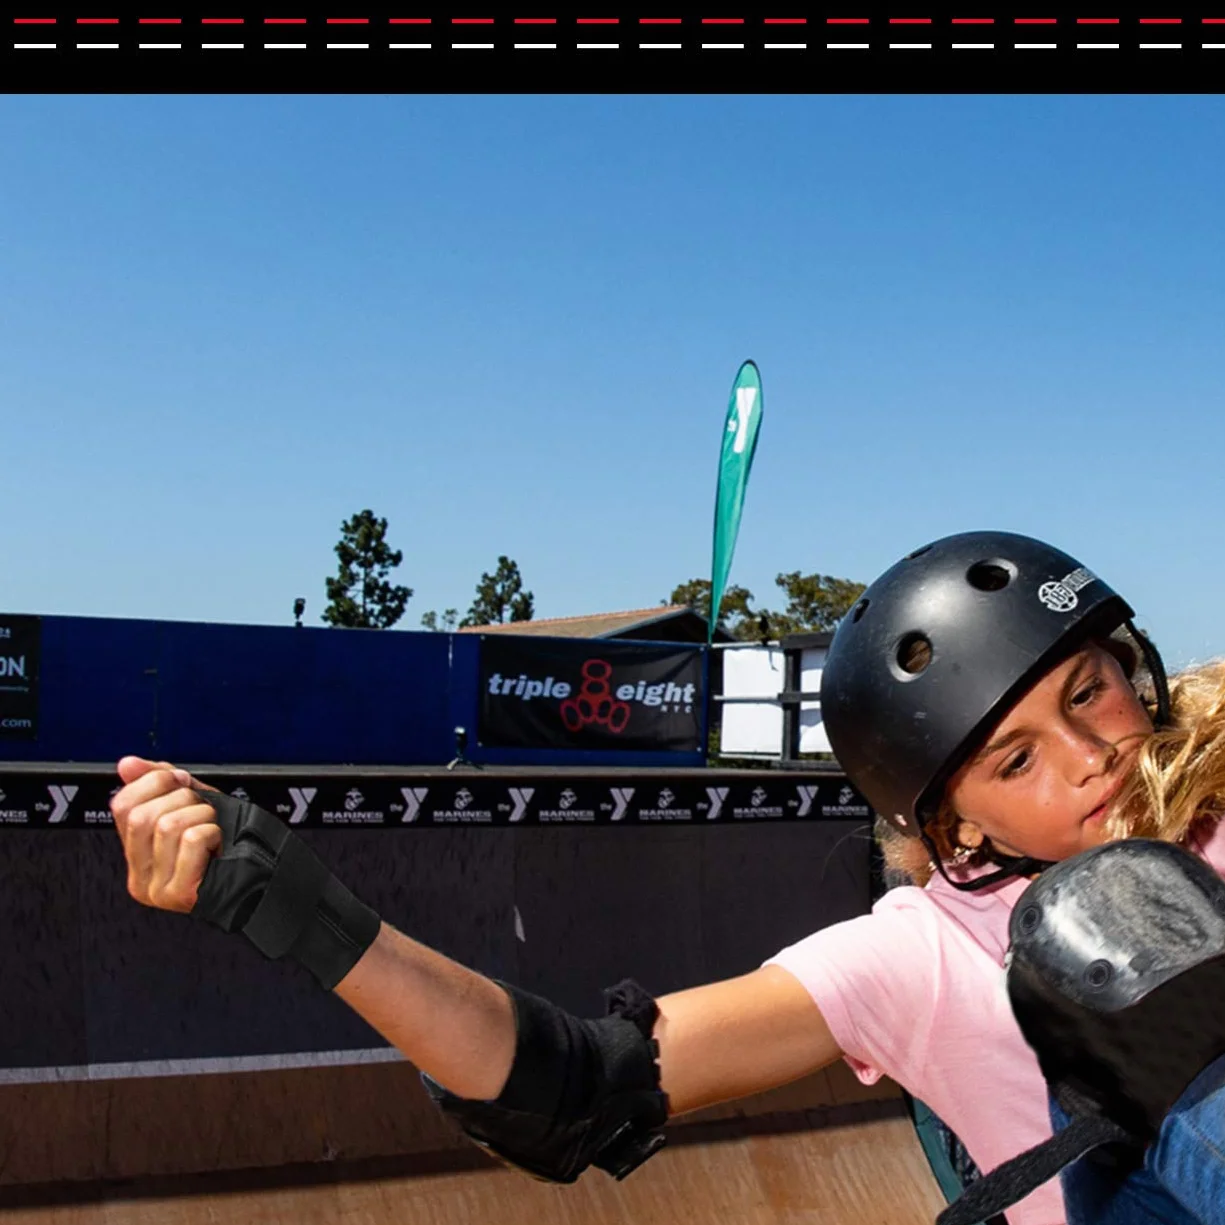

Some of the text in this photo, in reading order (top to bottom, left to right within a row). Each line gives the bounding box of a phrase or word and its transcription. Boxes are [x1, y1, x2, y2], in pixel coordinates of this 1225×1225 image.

[488, 673, 696, 706] triple eight
[35, 801, 50, 812] the
[322, 811, 384, 819] MARINES
[433, 810, 492, 818] MARINES
[539, 809, 595, 817] MARINES
[638, 808, 692, 816] MARINES
